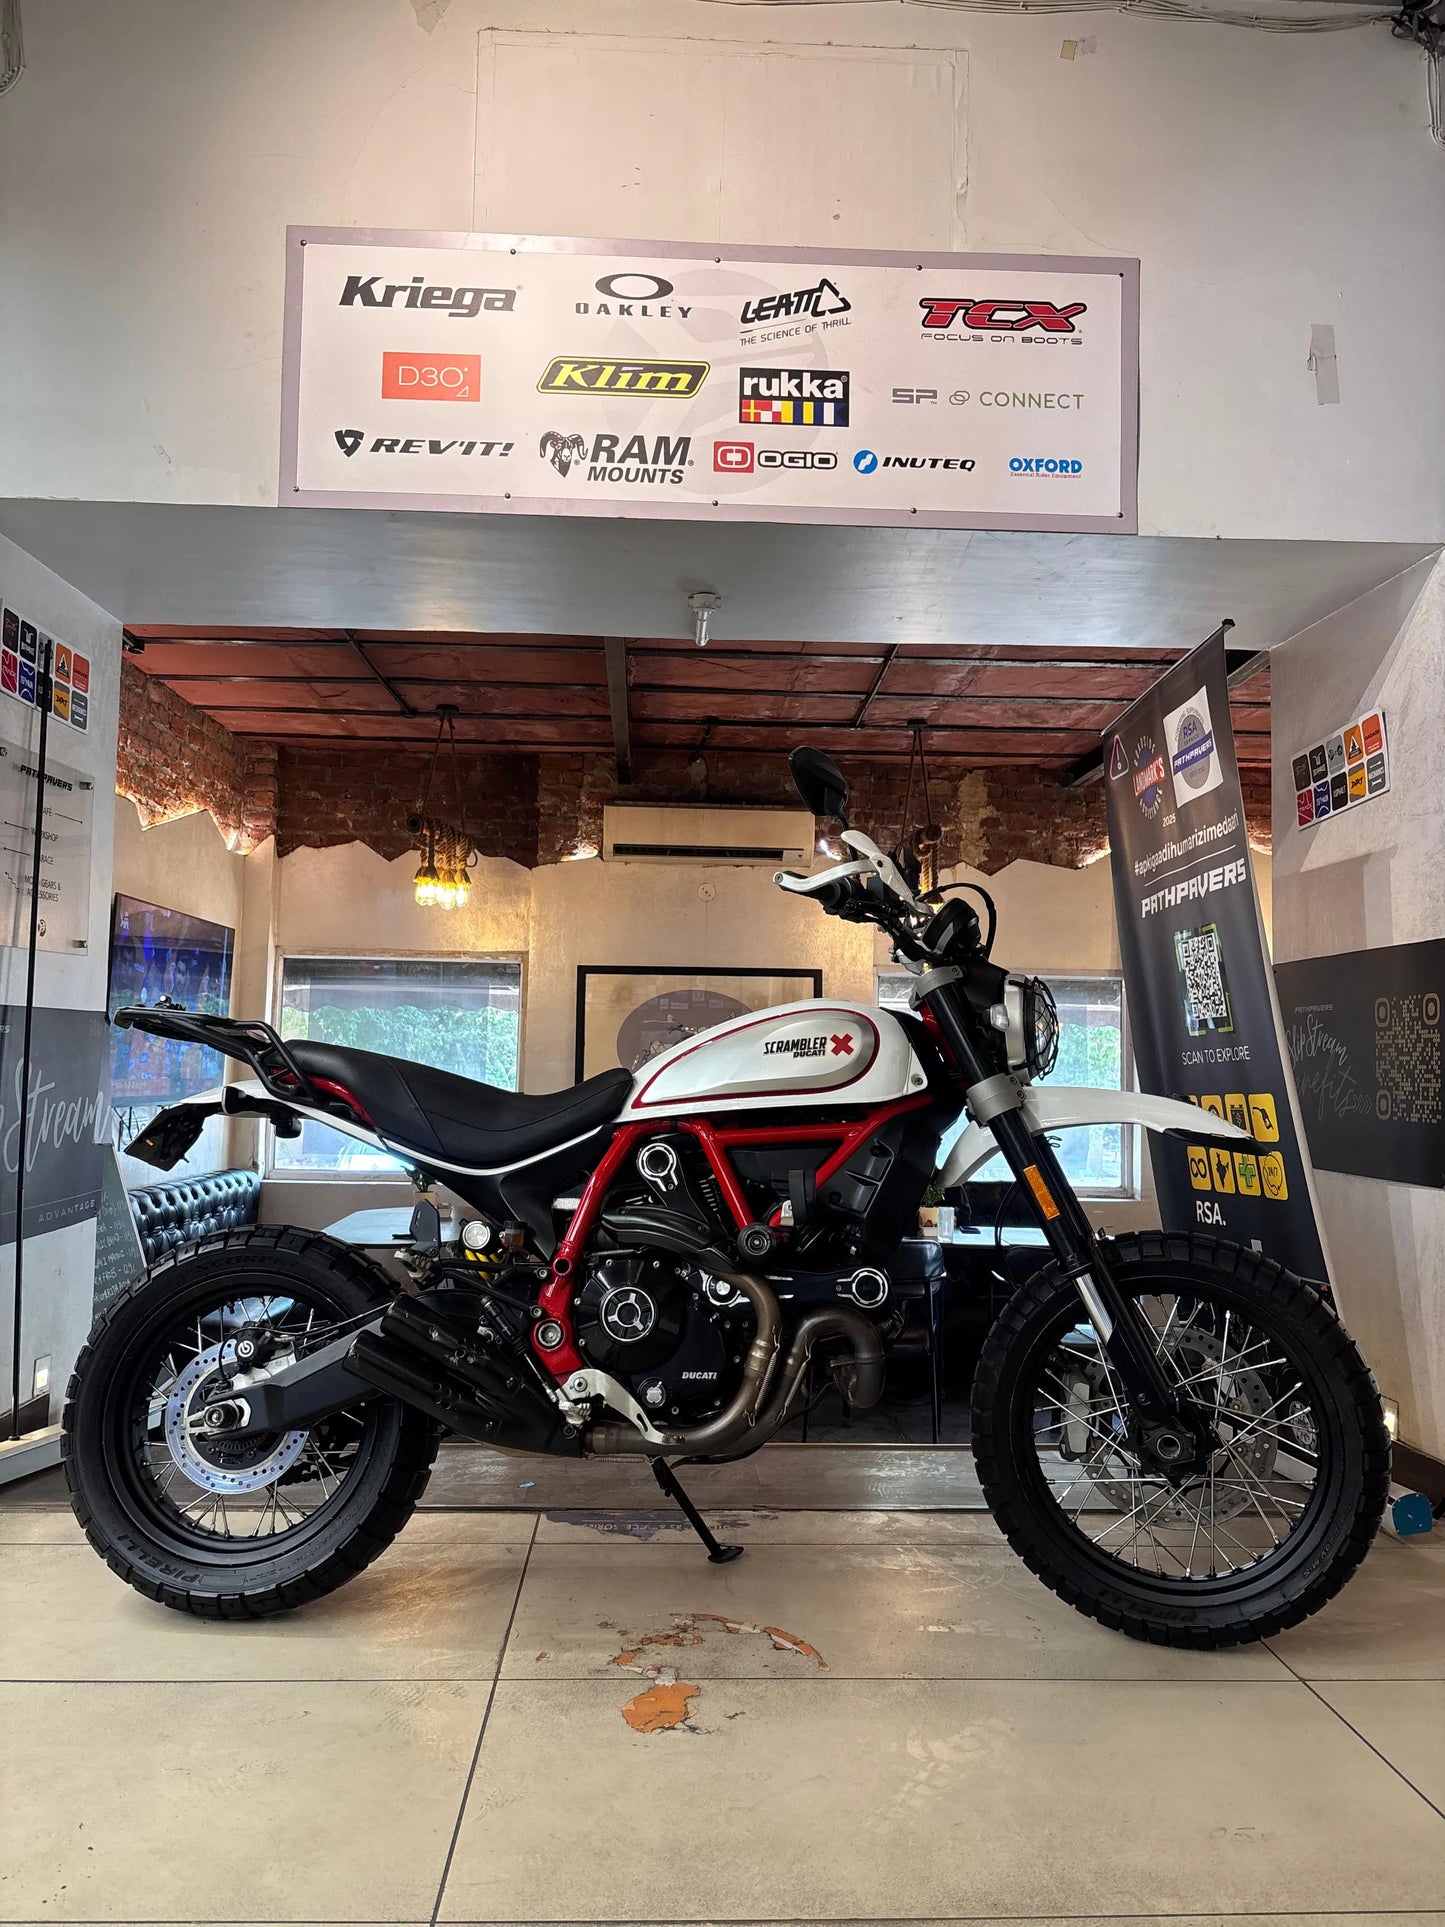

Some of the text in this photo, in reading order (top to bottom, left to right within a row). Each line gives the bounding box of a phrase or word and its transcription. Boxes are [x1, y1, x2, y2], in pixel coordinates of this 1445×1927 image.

[338, 275, 516, 318] Kriega
[575, 302, 692, 318] OAKLEY
[919, 297, 1087, 333] TCX
[740, 316, 852, 347] THE SCIENCE OF THRILL
[921, 332, 984, 343] FOCUS
[1021, 336, 1083, 346] BOOTS
[743, 371, 844, 399] rukka
[979, 391, 1085, 410] CONNECT
[590, 433, 693, 466] RAM
[757, 450, 838, 470] OGIO
[882, 456, 976, 473] INUTEQ
[1009, 457, 1083, 474] OXFORD
[586, 466, 685, 485] MOUNTS
[1183, 720, 1198, 740] RSA
[1173, 738, 1212, 769] PATHPAVERS
[20, 764, 73, 792] PATPAVERS
[1162, 812, 1177, 828] 2025
[1141, 857, 1247, 919] PATHPAVERS
[763, 1036, 828, 1055] SCRAMBLER
[793, 1049, 826, 1059] DUCATI
[1181, 1046, 1251, 1066] SCAN TO EXPLORE
[38, 1199, 96, 1224] ADVANTAGE
[1196, 1200, 1227, 1227] RSA.
[681, 1371, 718, 1381] DUCATI
[117, 1534, 201, 1584] PIRELLI
